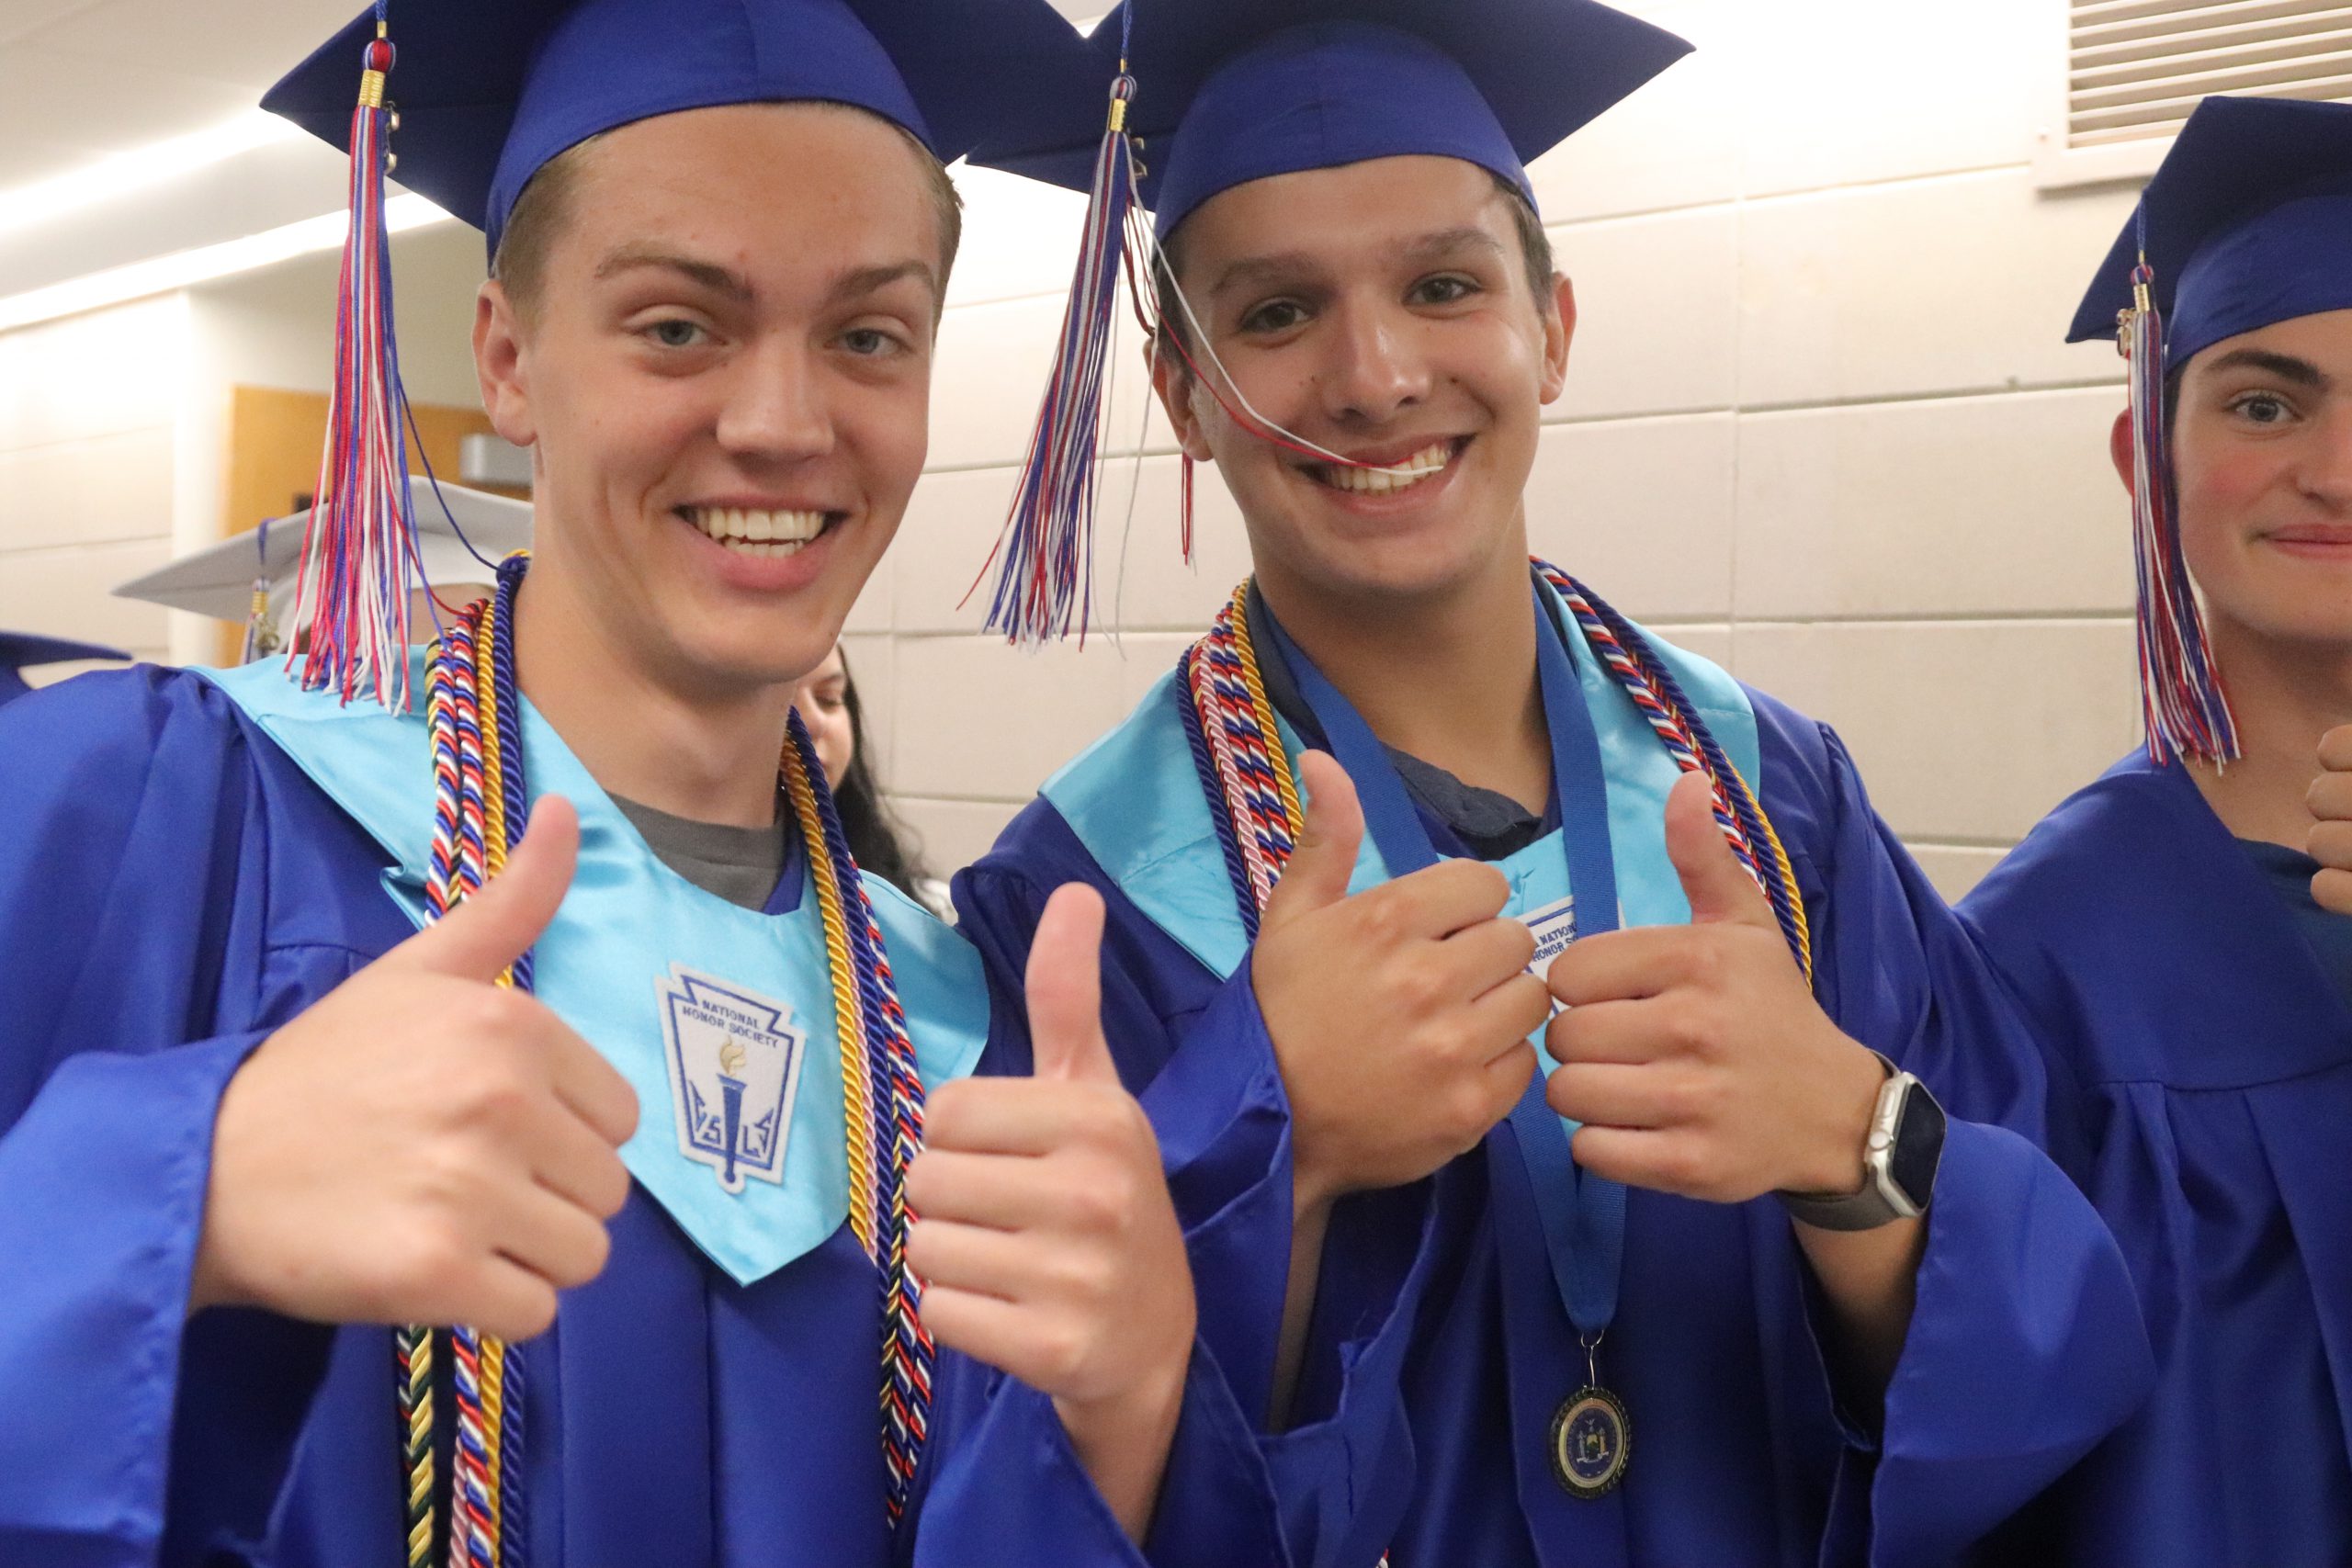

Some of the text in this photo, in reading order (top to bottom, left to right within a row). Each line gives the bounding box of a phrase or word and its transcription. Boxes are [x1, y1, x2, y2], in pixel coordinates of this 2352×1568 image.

[1539, 921, 1577, 944] NATION
[1532, 942, 1565, 962] HONOR
[682, 1006, 778, 1047] HONOR SOCIETY
[702, 999, 760, 1030] NATIONAL
